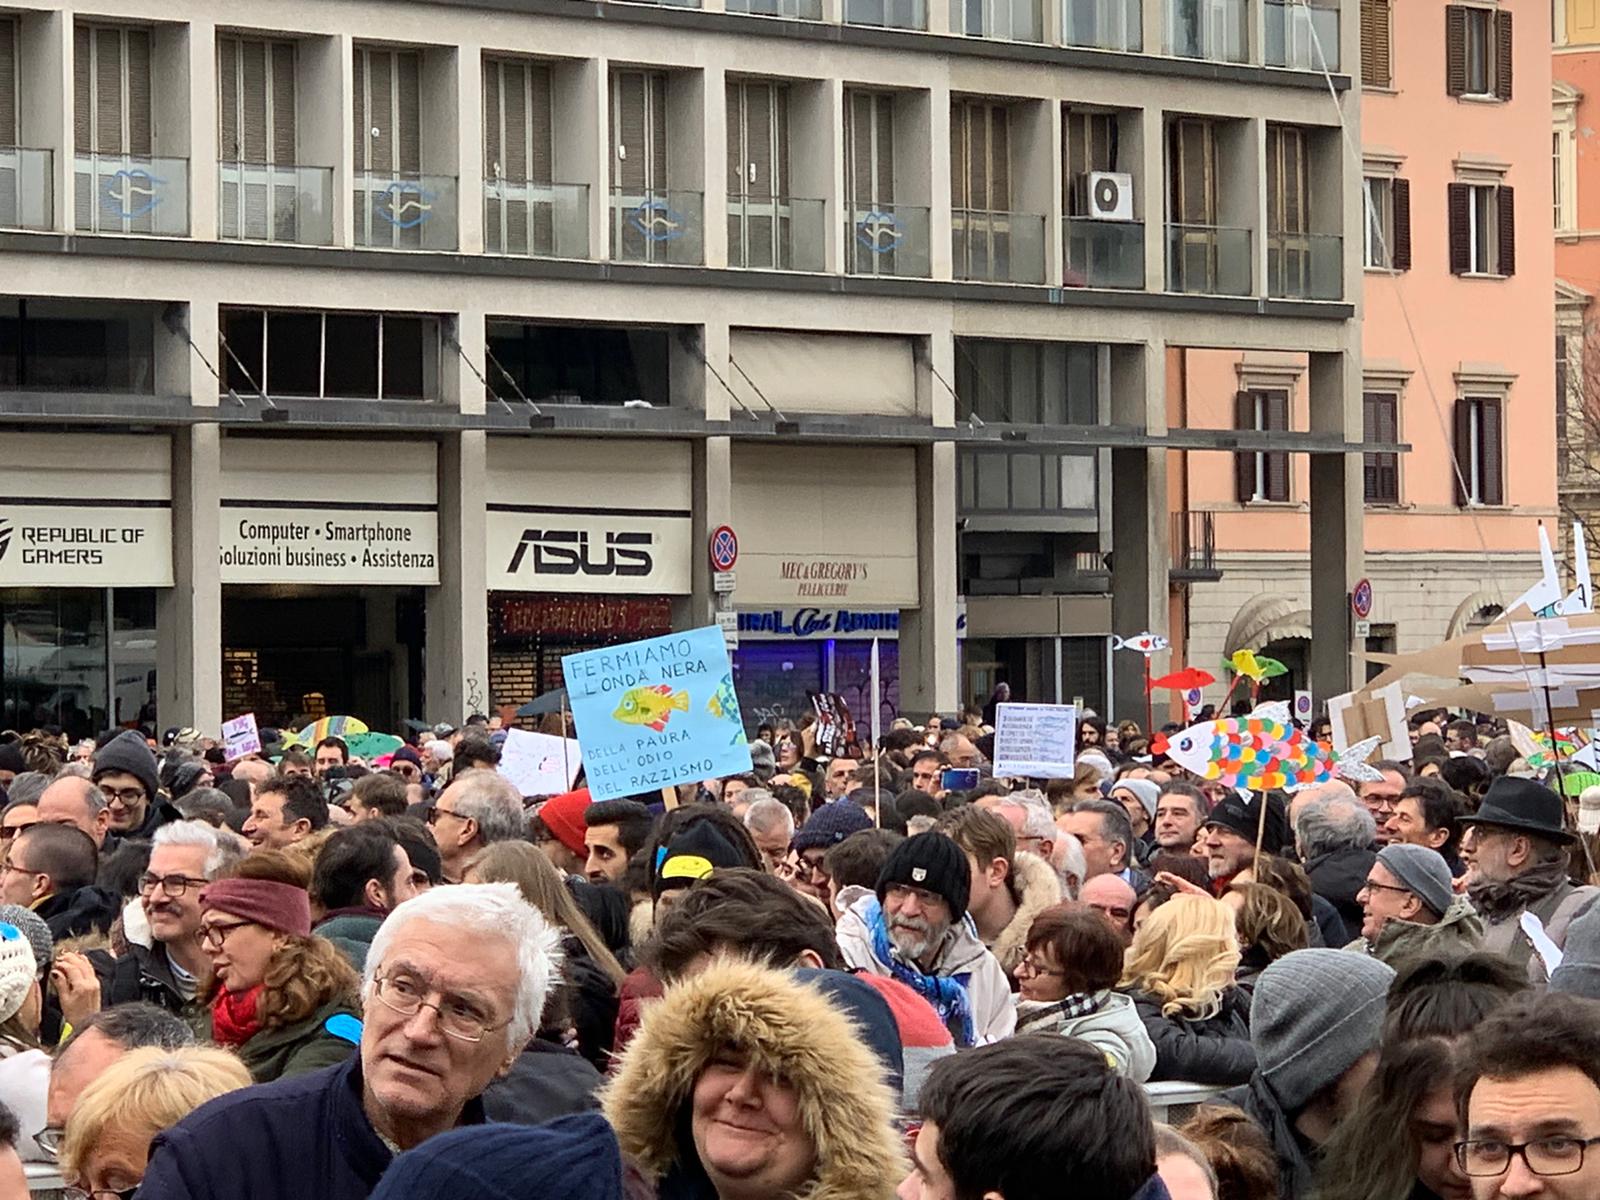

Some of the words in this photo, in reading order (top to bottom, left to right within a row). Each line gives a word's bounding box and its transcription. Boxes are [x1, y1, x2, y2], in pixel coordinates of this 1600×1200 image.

[22, 527, 117, 546] REPUBLIC
[122, 528, 145, 543] OF
[240, 519, 310, 545] Computer
[325, 520, 412, 547] Smartphone
[22, 549, 103, 565] GAMERS
[286, 547, 347, 567] business
[362, 548, 434, 568] Assistenza
[506, 529, 653, 576] ASUS
[834, 610, 899, 633] ADMIR
[571, 639, 692, 679] FERMIAMO
[661, 659, 707, 679] NERA
[587, 743, 626, 760] DELLA
[636, 729, 692, 750] PAURA
[597, 781, 623, 796] DEL
[630, 758, 714, 787] RAZZISMO
